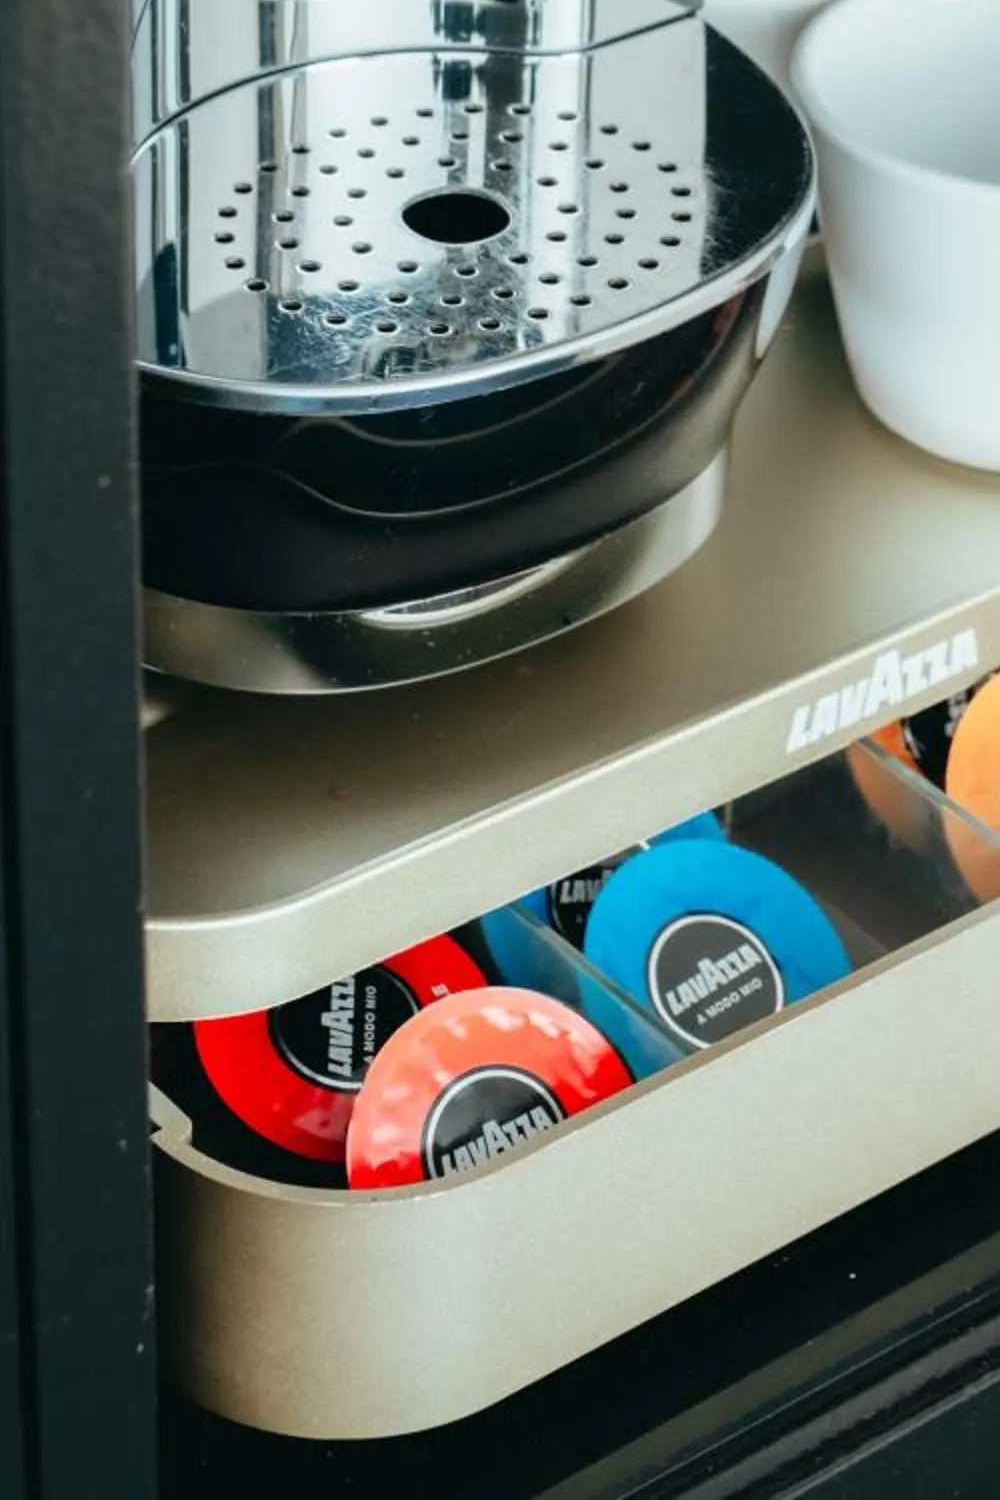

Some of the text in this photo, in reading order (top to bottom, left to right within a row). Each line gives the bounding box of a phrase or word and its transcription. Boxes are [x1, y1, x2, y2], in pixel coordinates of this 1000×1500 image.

[786, 627, 979, 754] LAVAZZA
[364, 985, 378, 1008] MIO
[665, 943, 763, 1017] LAVAZZA
[362, 1012, 376, 1053] MODO
[440, 1105, 551, 1177] LAVAZZA
